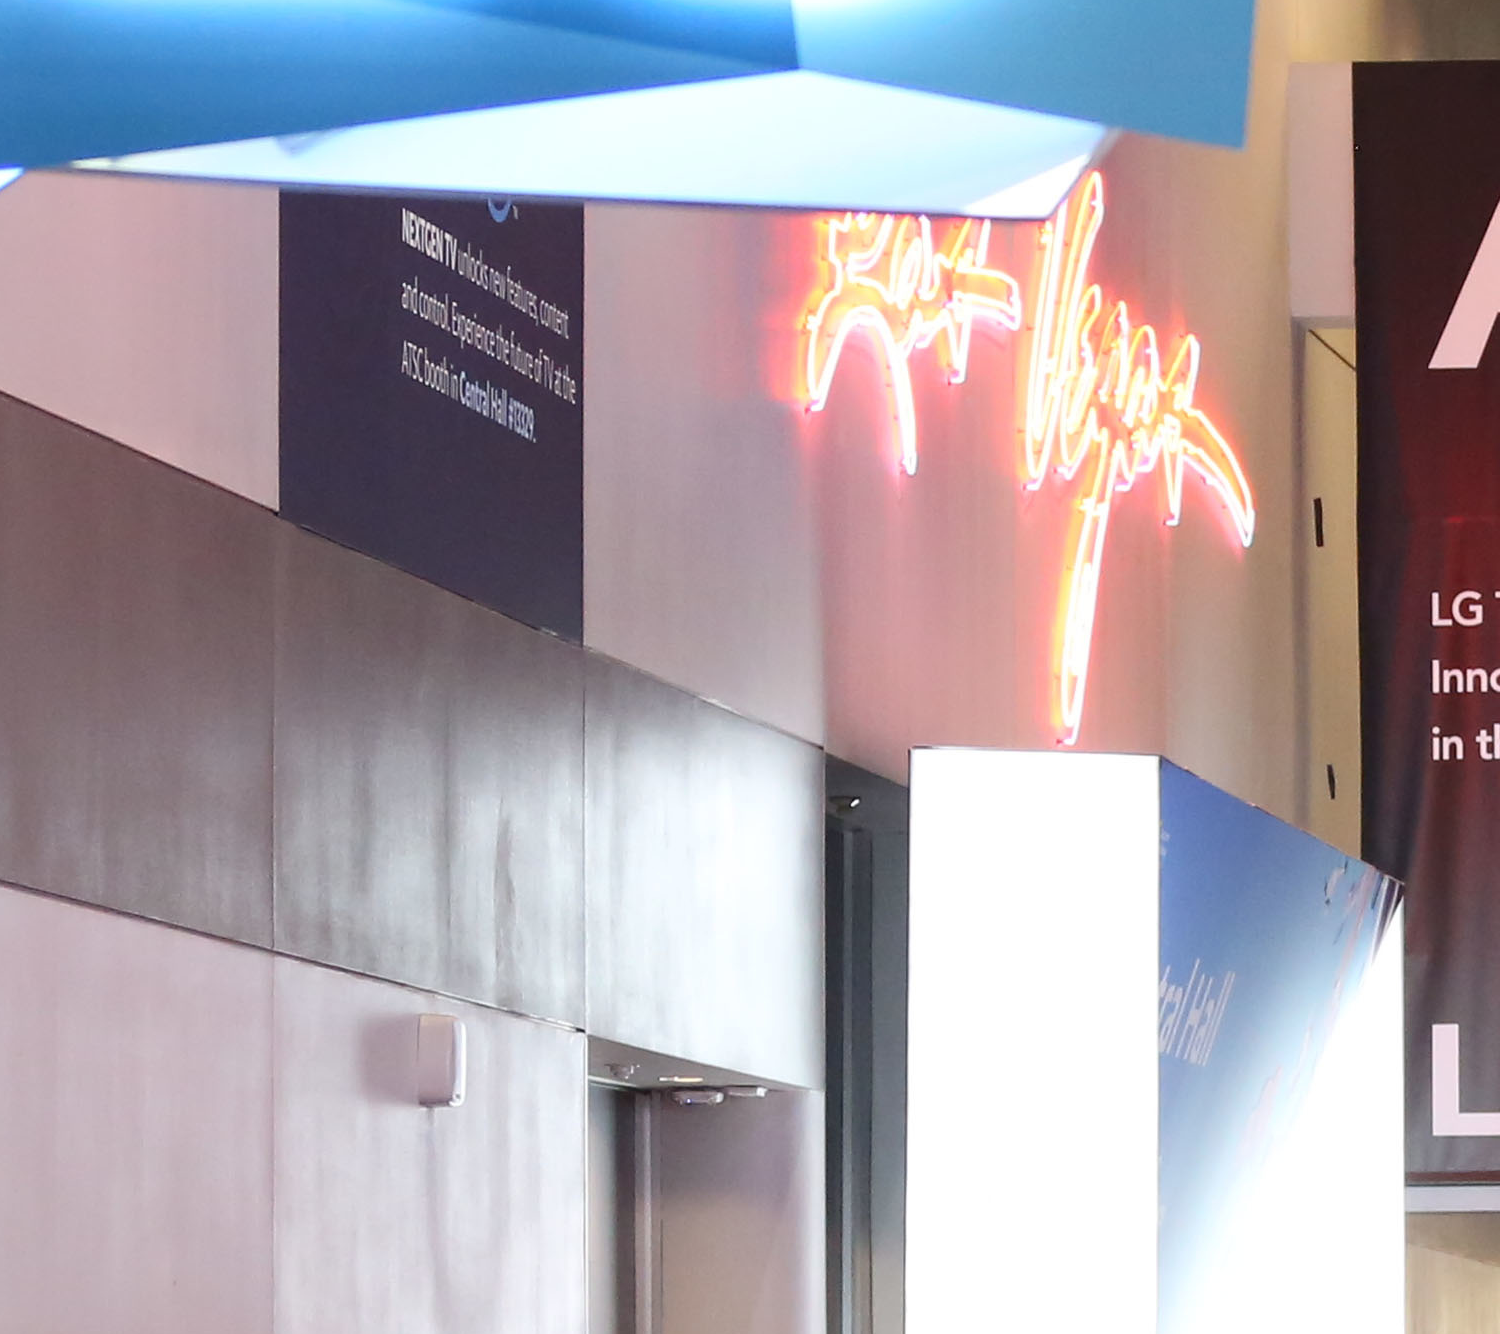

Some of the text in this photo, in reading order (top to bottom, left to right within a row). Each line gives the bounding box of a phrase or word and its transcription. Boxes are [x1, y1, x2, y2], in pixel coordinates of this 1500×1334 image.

[402, 208, 443, 265] NEXTGEN
[444, 230, 457, 271] TV
[402, 276, 418, 315] and
[402, 339, 424, 383] ATSC
[459, 370, 489, 417] Central
[490, 380, 508, 427] Hall
[1431, 590, 1483, 627] LG
[1431, 726, 1464, 761] in
